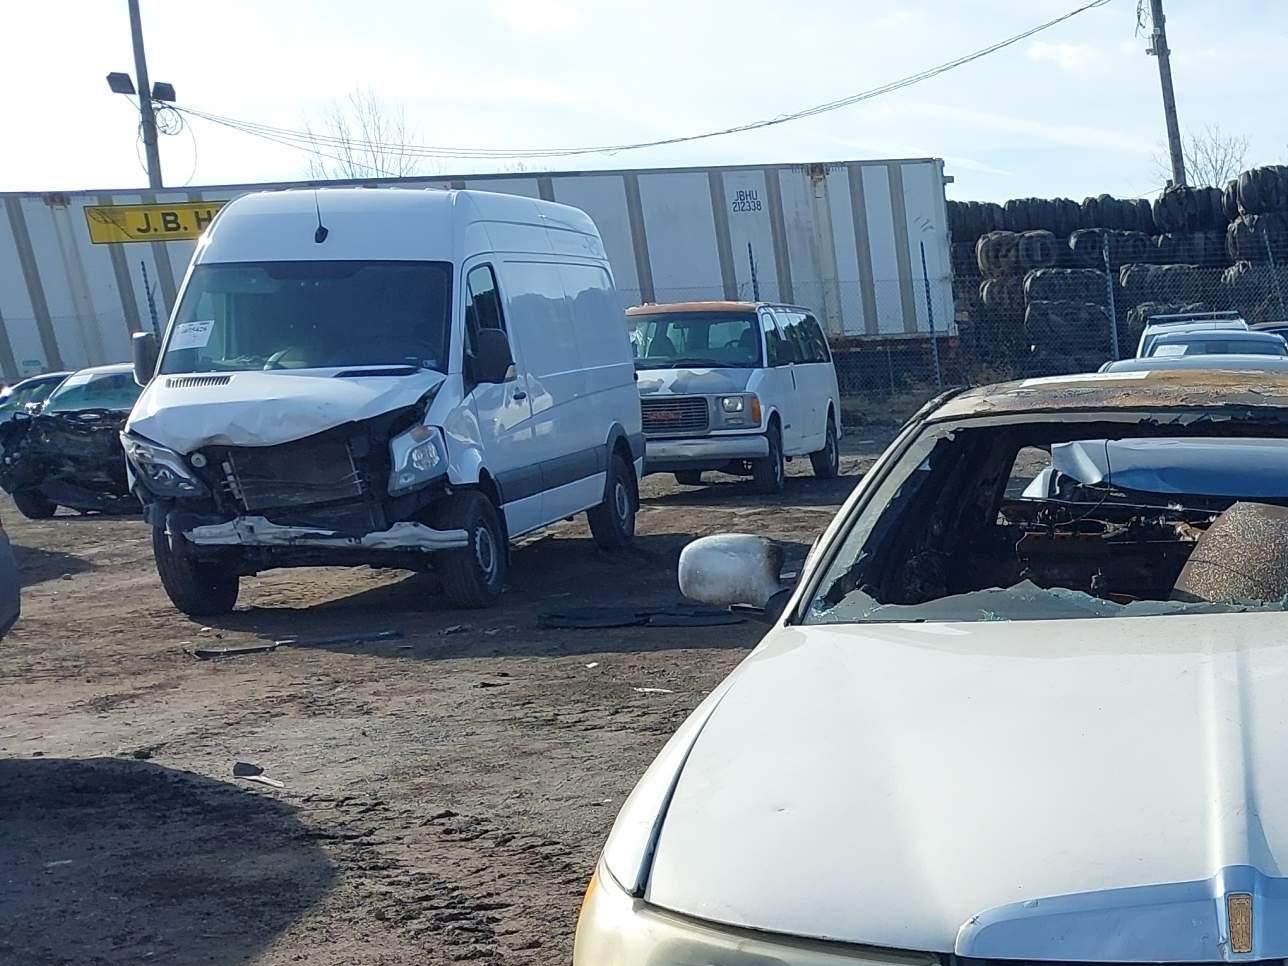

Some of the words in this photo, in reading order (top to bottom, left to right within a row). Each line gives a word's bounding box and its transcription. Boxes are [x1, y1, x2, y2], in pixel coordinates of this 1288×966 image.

[735, 190, 758, 201] JBHU
[732, 200, 762, 212] 212338
[136, 211, 188, 233] J.B.
